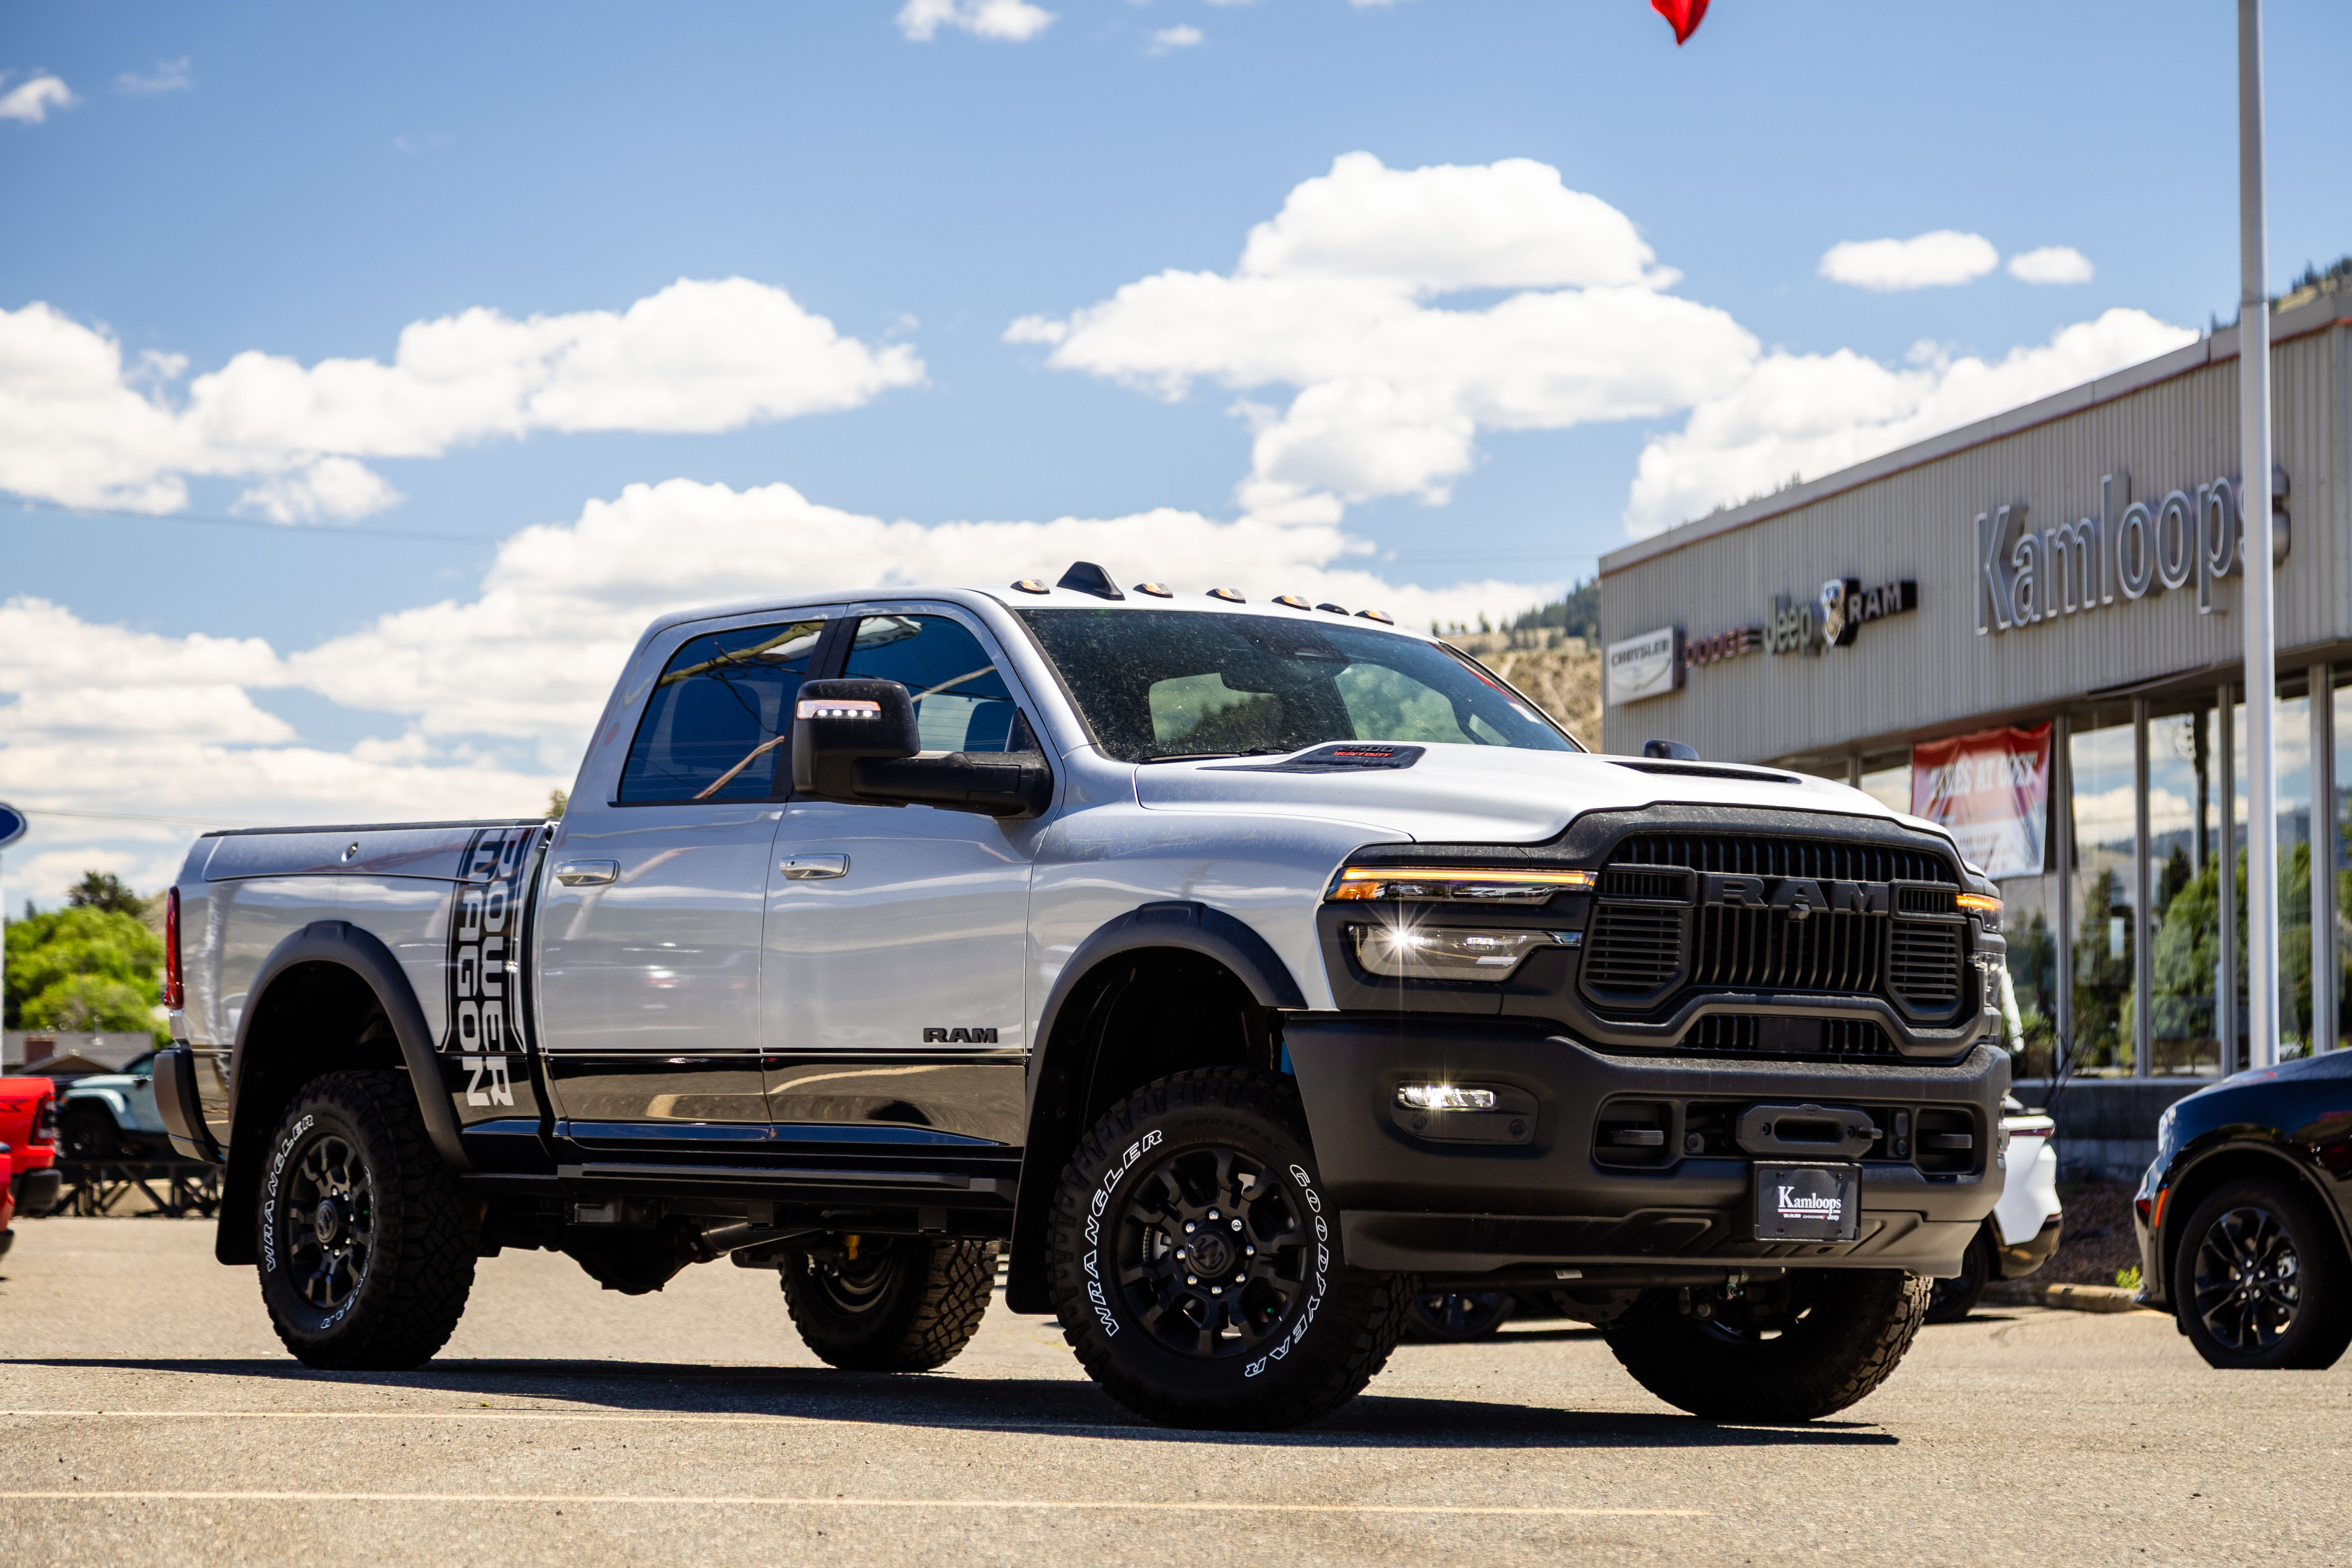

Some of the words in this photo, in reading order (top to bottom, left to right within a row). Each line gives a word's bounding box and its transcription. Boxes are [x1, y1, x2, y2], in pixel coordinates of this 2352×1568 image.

[1976, 474, 2274, 636] Kamloop
[1763, 594, 1812, 657] Jeep
[1848, 584, 1902, 625] RAM
[1611, 638, 1671, 668] CHRYSLER
[1685, 625, 1750, 668] DODGE
[1703, 873, 1889, 915] RAM
[458, 829, 504, 1106] WAGON
[481, 828, 525, 1106] POWER
[923, 1028, 998, 1043] RAM
[263, 1114, 314, 1272] WRANGLER
[1778, 1186, 1841, 1214] Kamloops
[1084, 1130, 1162, 1337] WRANGLER
[1244, 1165, 1329, 1377] GOODYEAR
